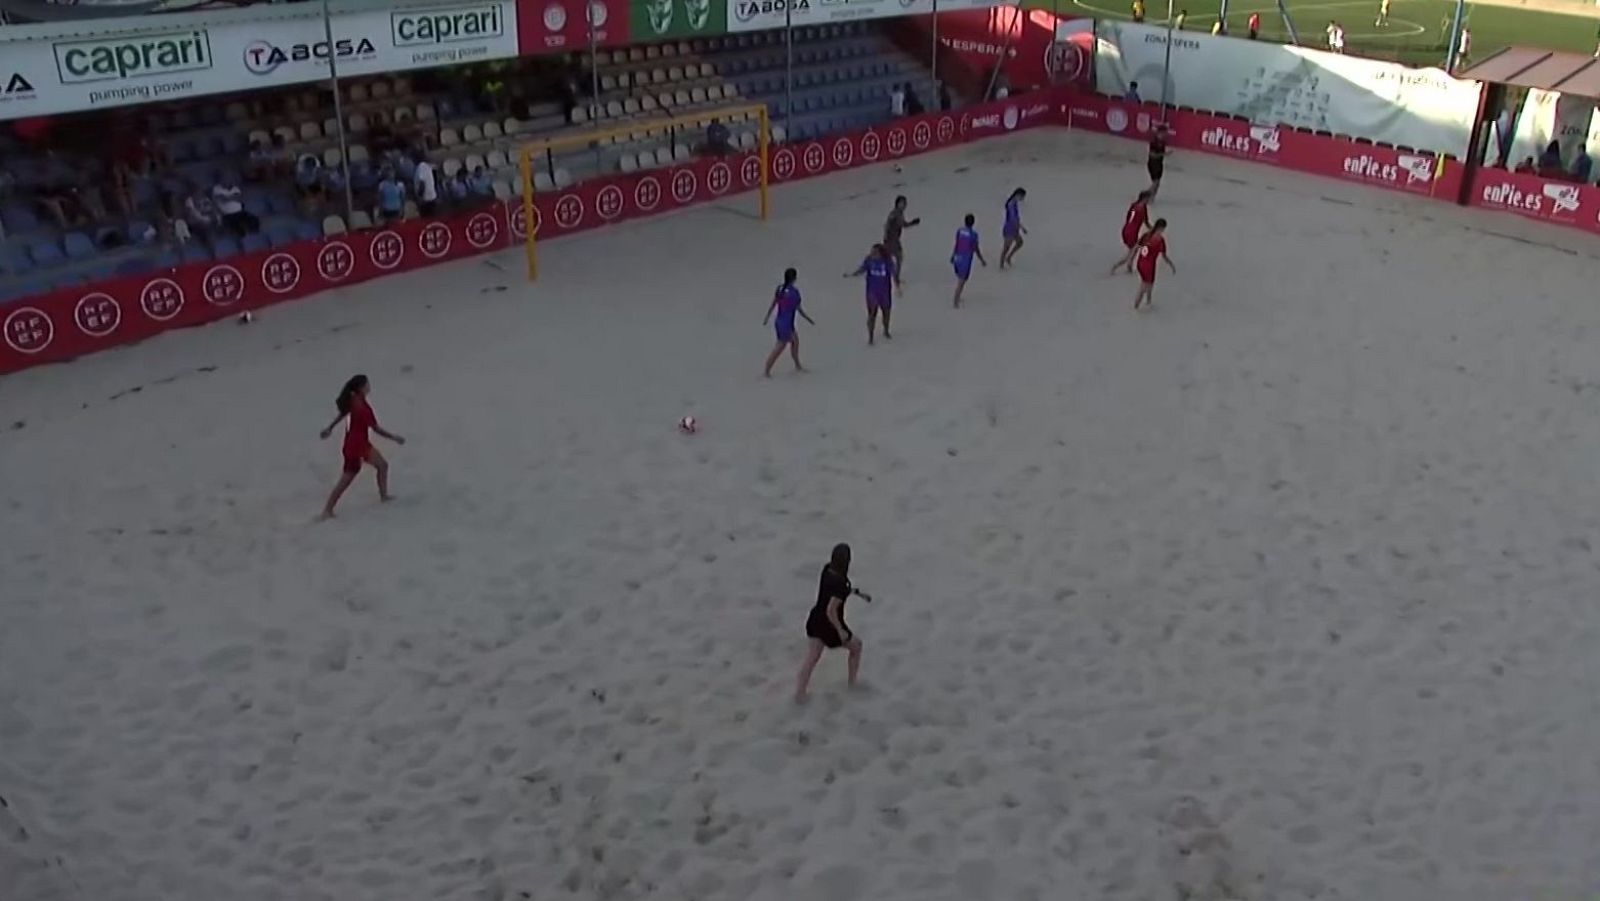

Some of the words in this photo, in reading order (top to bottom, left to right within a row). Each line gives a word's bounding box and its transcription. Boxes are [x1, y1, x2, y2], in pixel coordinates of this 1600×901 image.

[398, 6, 497, 43] caprari
[65, 31, 204, 77] caprari
[249, 38, 376, 65] TABOSA
[90, 84, 149, 103] pumping
[154, 80, 193, 97] power
[1201, 127, 1250, 151] enPie.es
[1344, 155, 1397, 180] enPie.es
[1483, 182, 1542, 210] enPie.es
